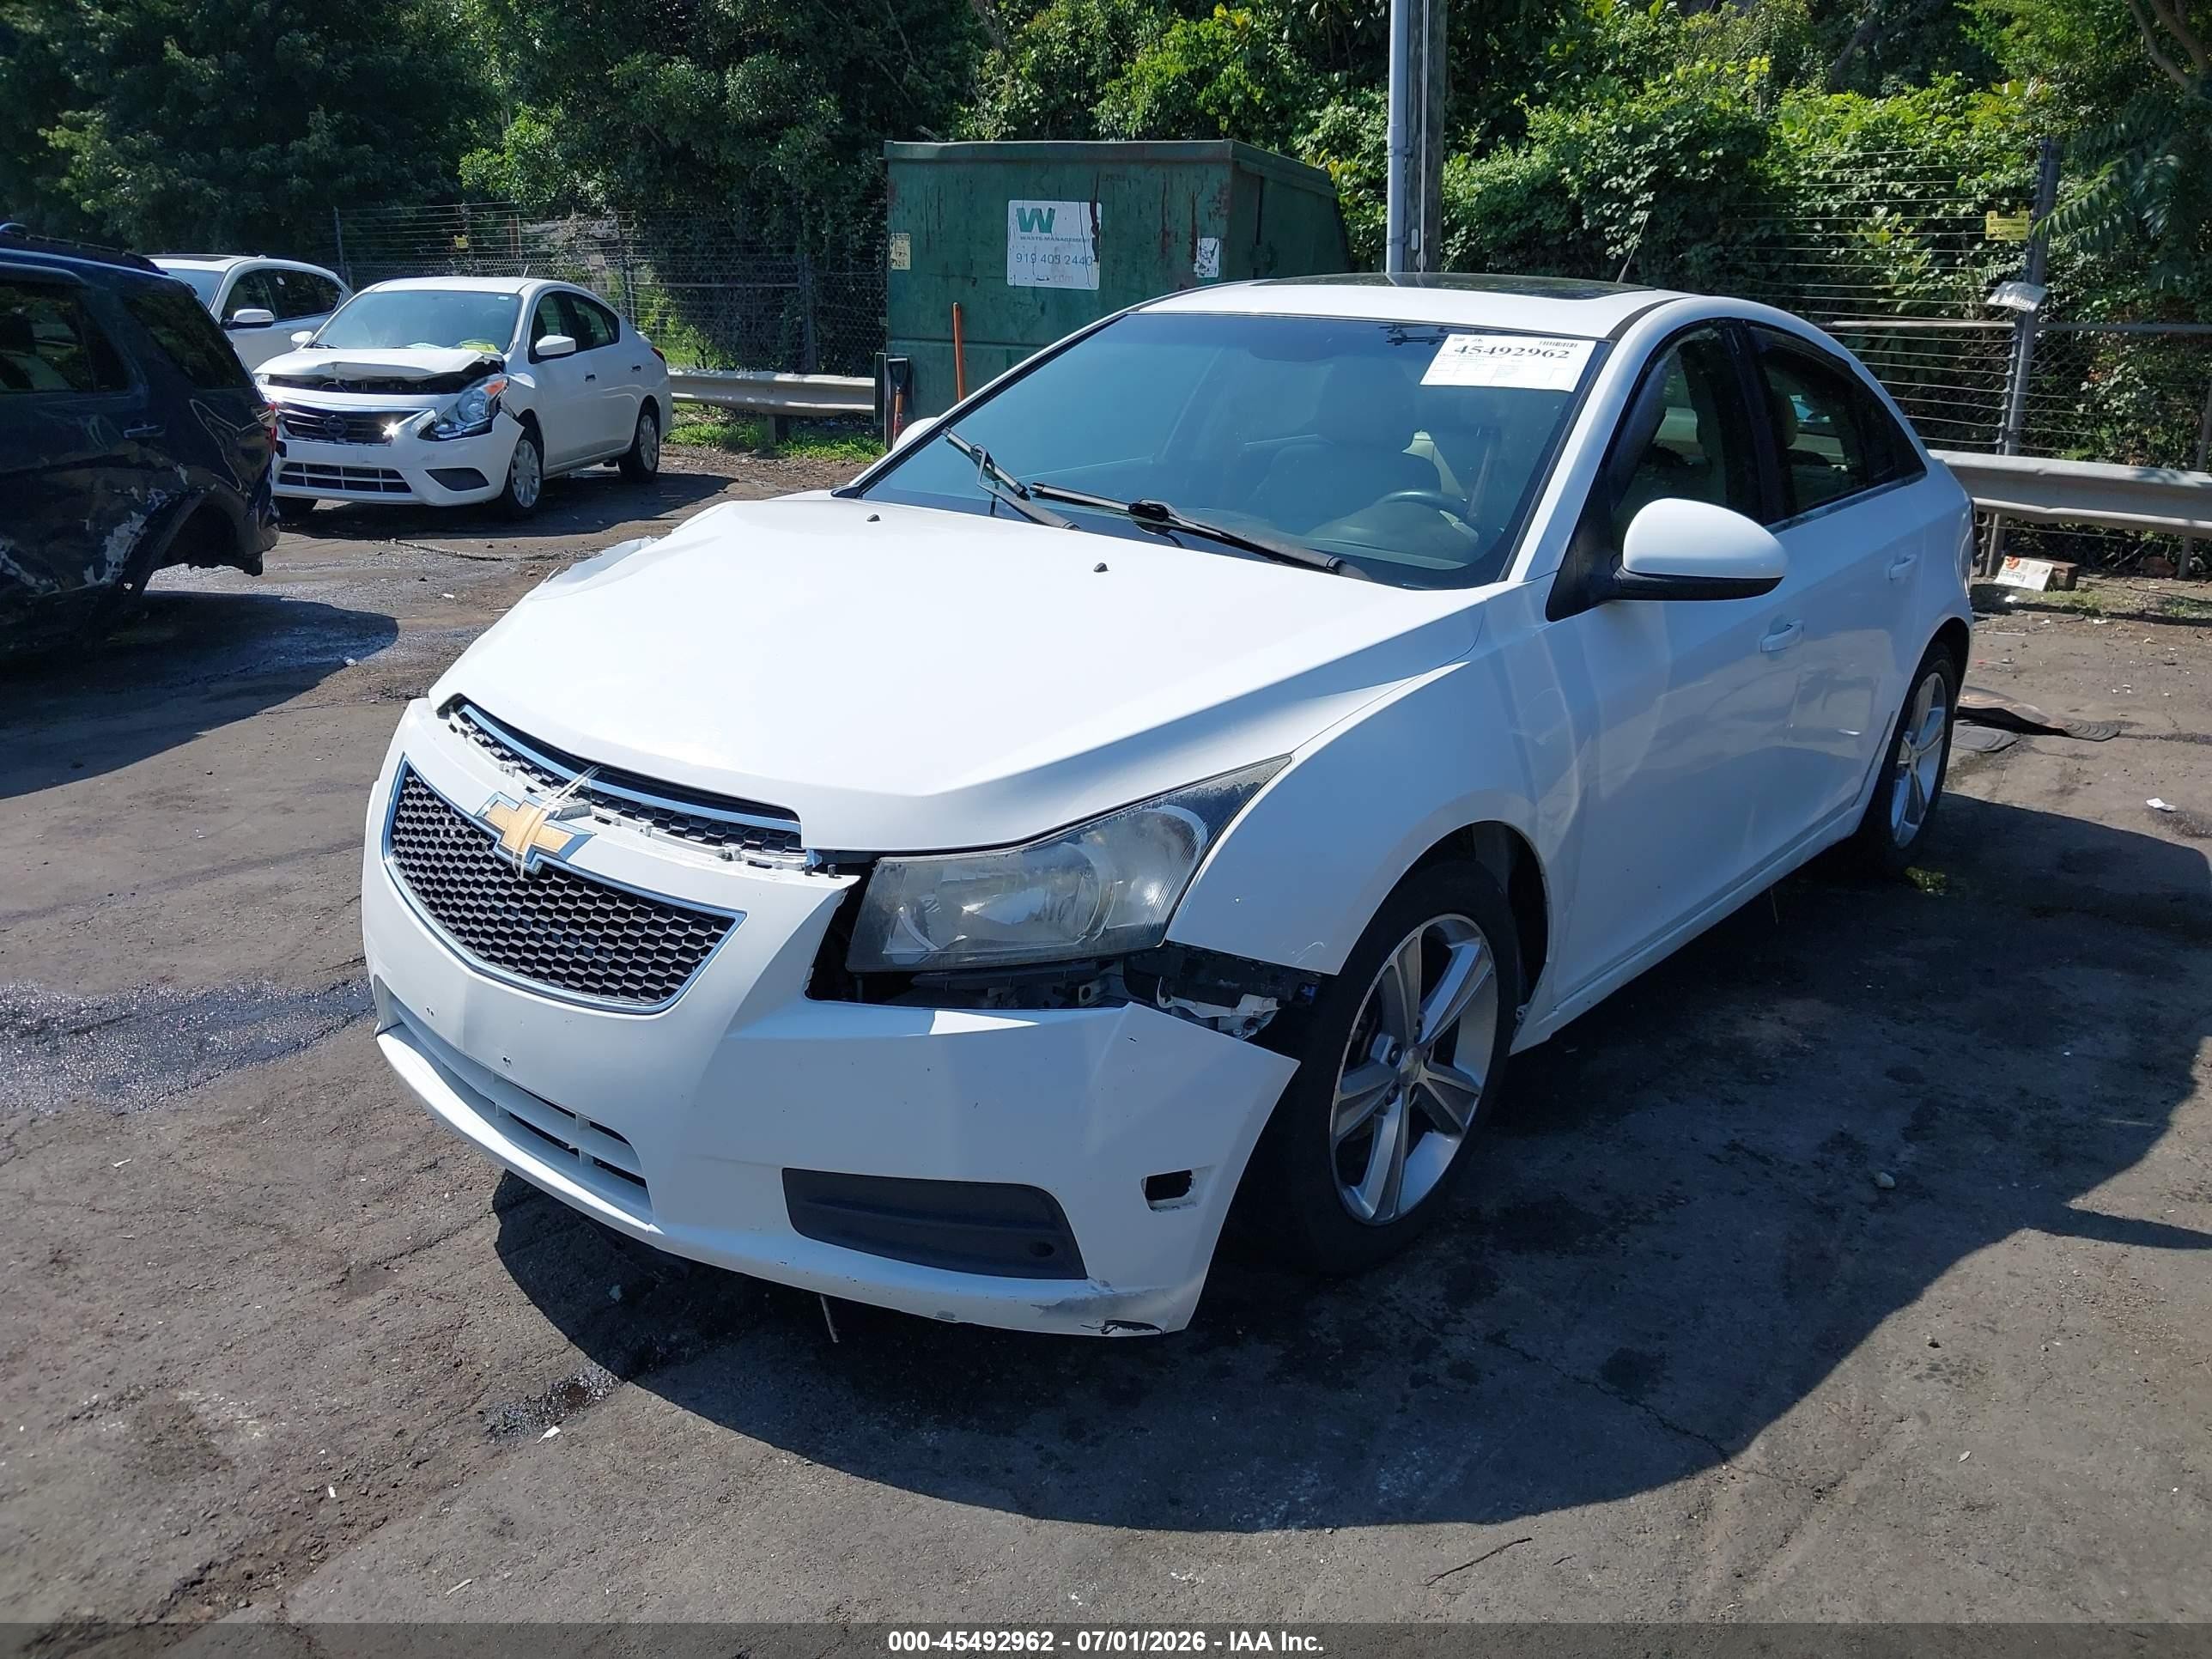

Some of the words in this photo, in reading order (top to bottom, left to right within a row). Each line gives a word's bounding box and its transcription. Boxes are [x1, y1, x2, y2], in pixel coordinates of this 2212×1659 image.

[1016, 252, 1037, 263] 919
[1063, 254, 1093, 266] 2440
[1454, 344, 1571, 359] 45492962
